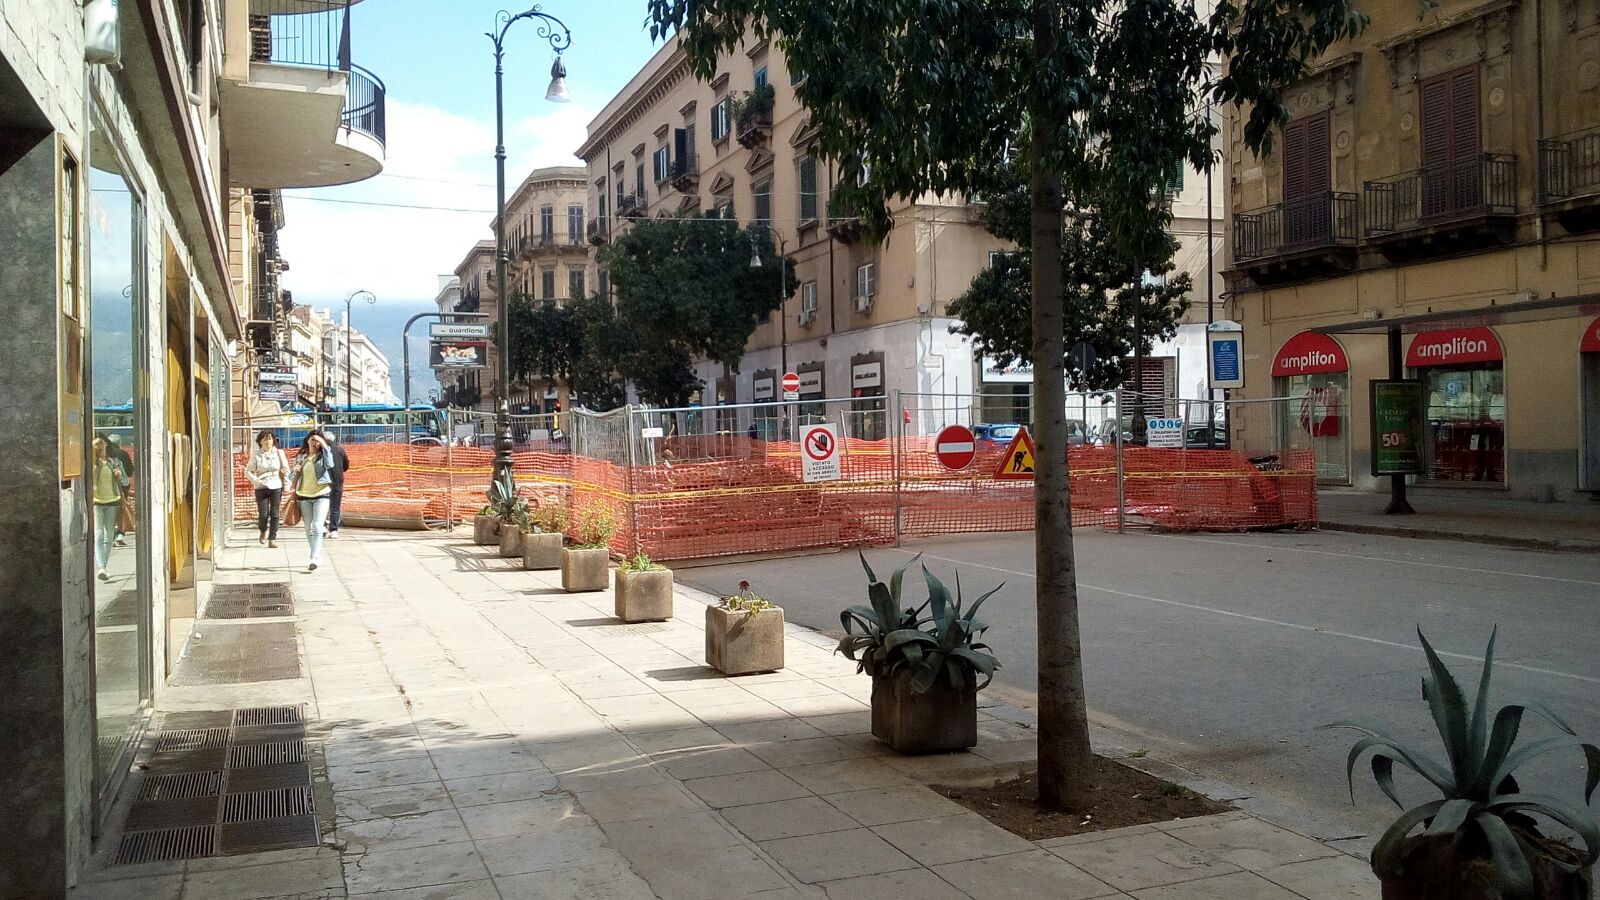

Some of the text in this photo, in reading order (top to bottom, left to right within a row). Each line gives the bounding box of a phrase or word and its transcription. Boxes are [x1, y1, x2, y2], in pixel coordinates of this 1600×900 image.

[1416, 336, 1488, 360] amplifon
[1280, 349, 1336, 372] amplifon
[1381, 432, 1408, 447] 50%
